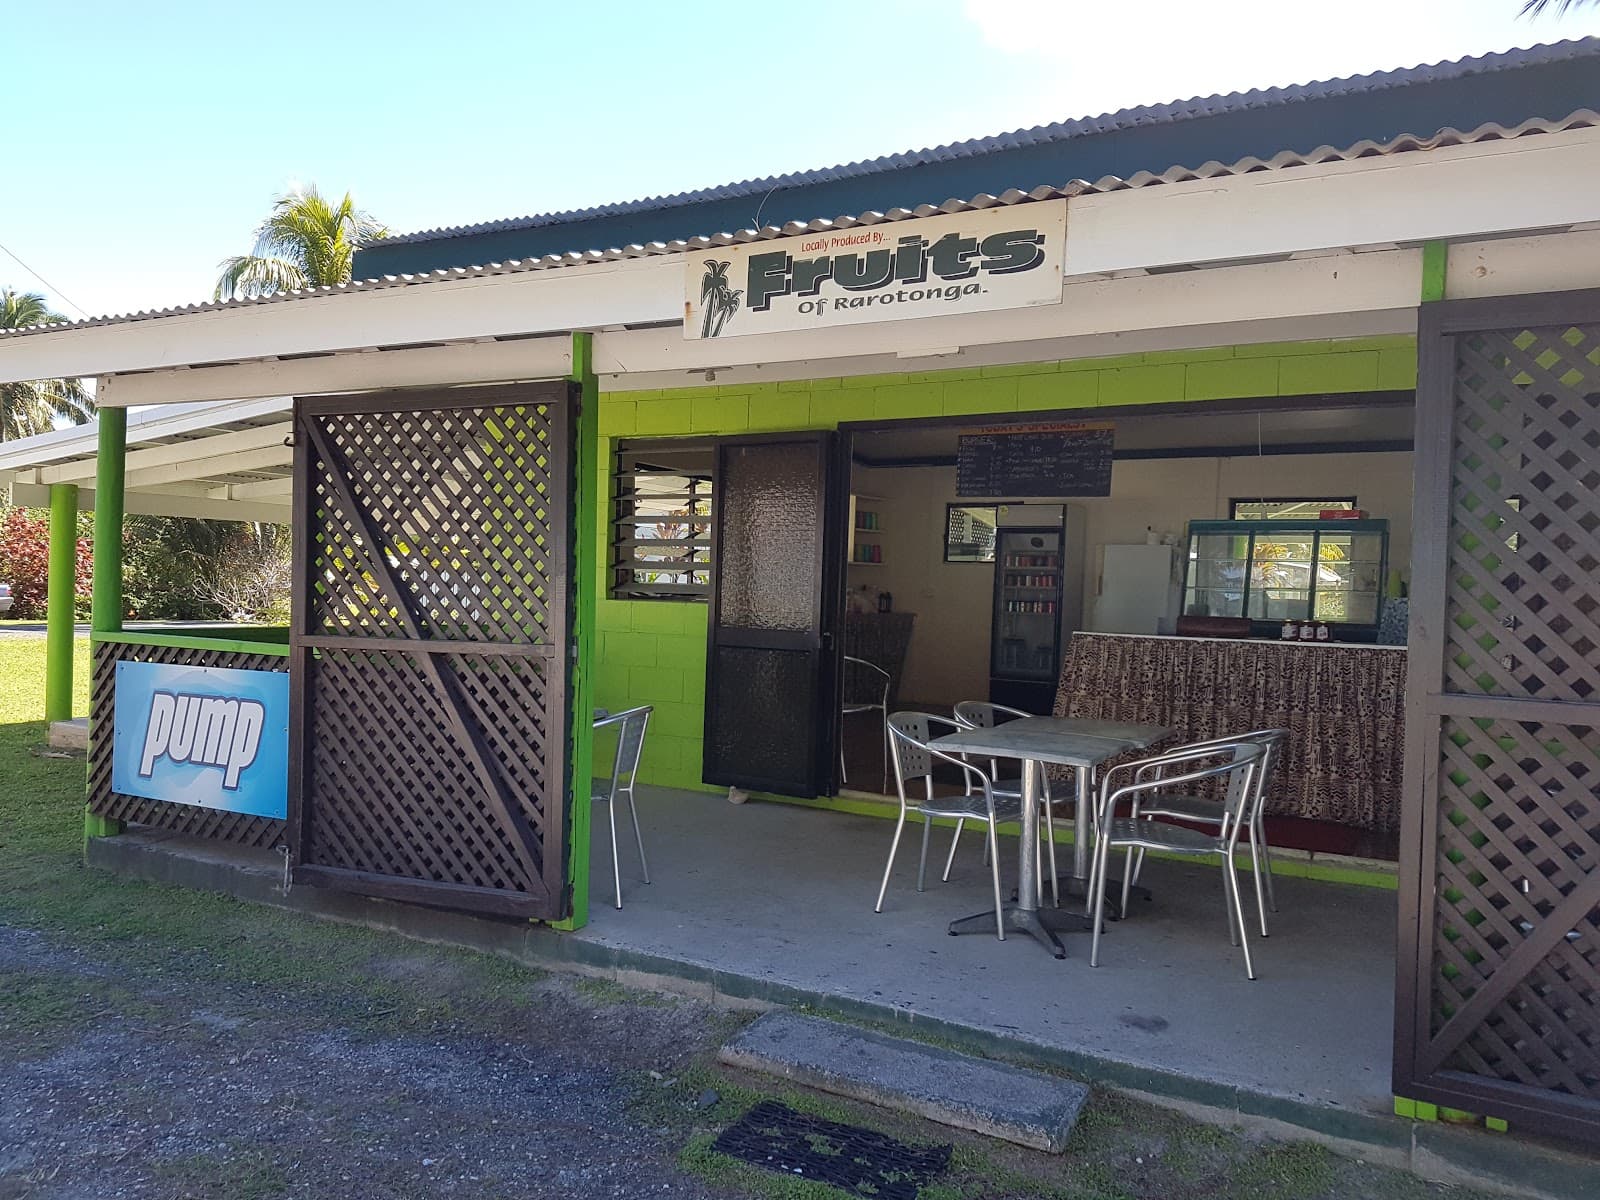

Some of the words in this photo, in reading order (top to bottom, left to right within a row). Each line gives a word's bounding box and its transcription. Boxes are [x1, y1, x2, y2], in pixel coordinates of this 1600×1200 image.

[747, 229, 1045, 312] Fruits
[801, 236, 829, 253] Locally
[831, 232, 870, 250] Produced
[871, 231, 891, 248] By...
[798, 298, 828, 316] Of
[834, 283, 988, 311] Rarotonga.
[138, 691, 265, 791] pump
